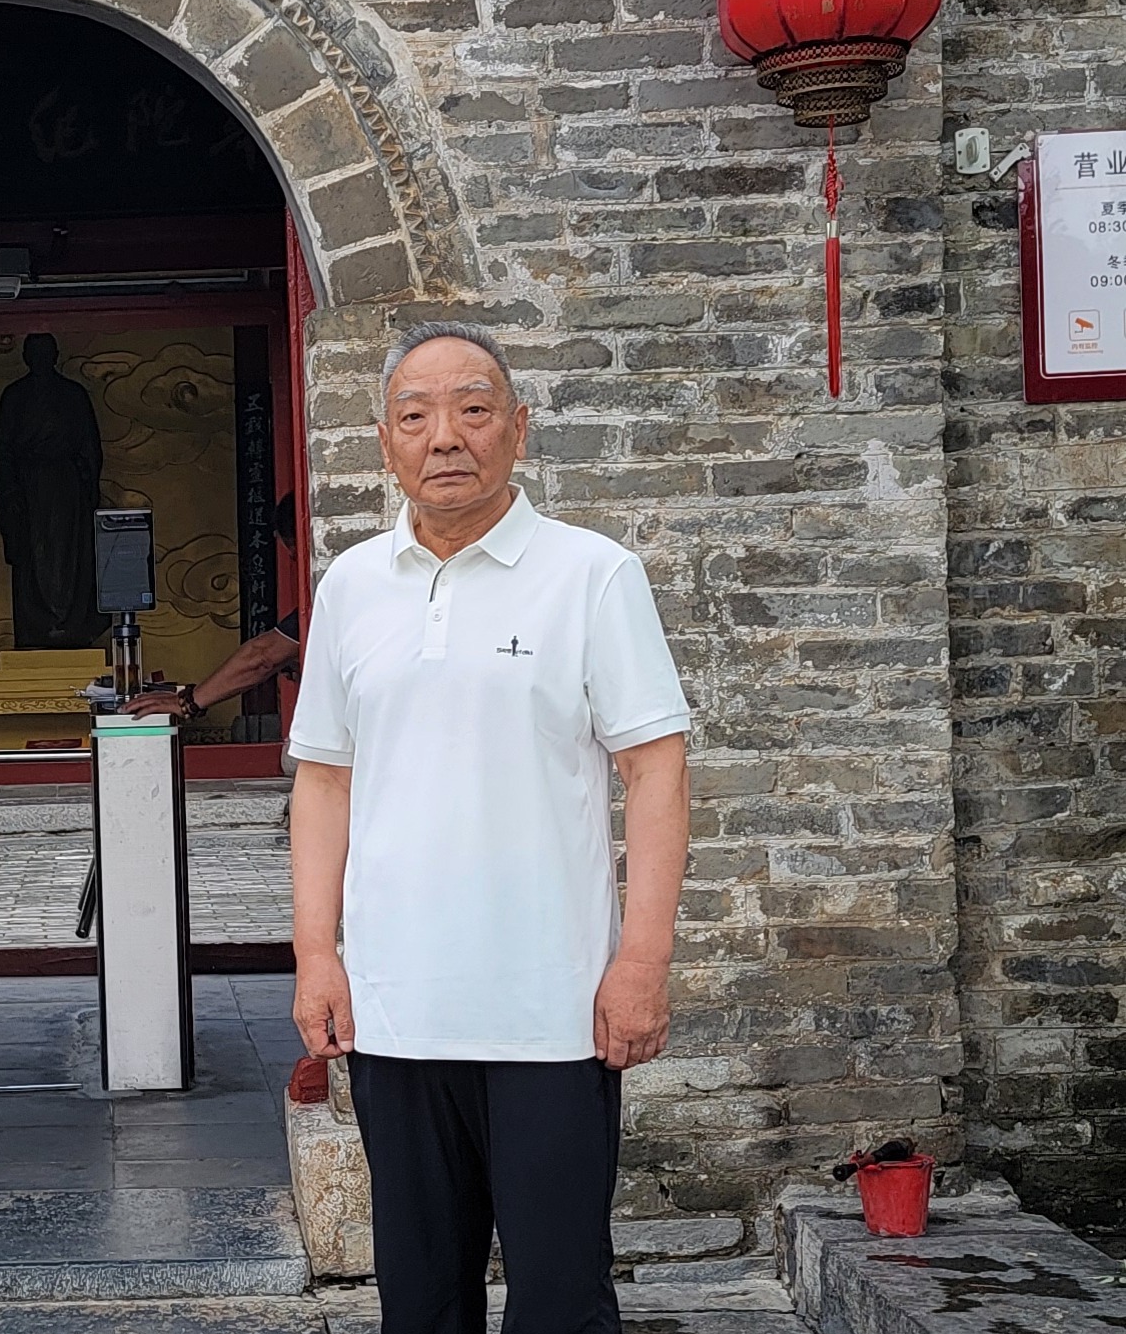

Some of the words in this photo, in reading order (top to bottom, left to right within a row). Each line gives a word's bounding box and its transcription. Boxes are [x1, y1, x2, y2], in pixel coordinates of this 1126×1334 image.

[1074, 150, 1126, 179] 营业
[1107, 254, 1126, 269] 冬
[1090, 274, 1126, 287] 09:0
